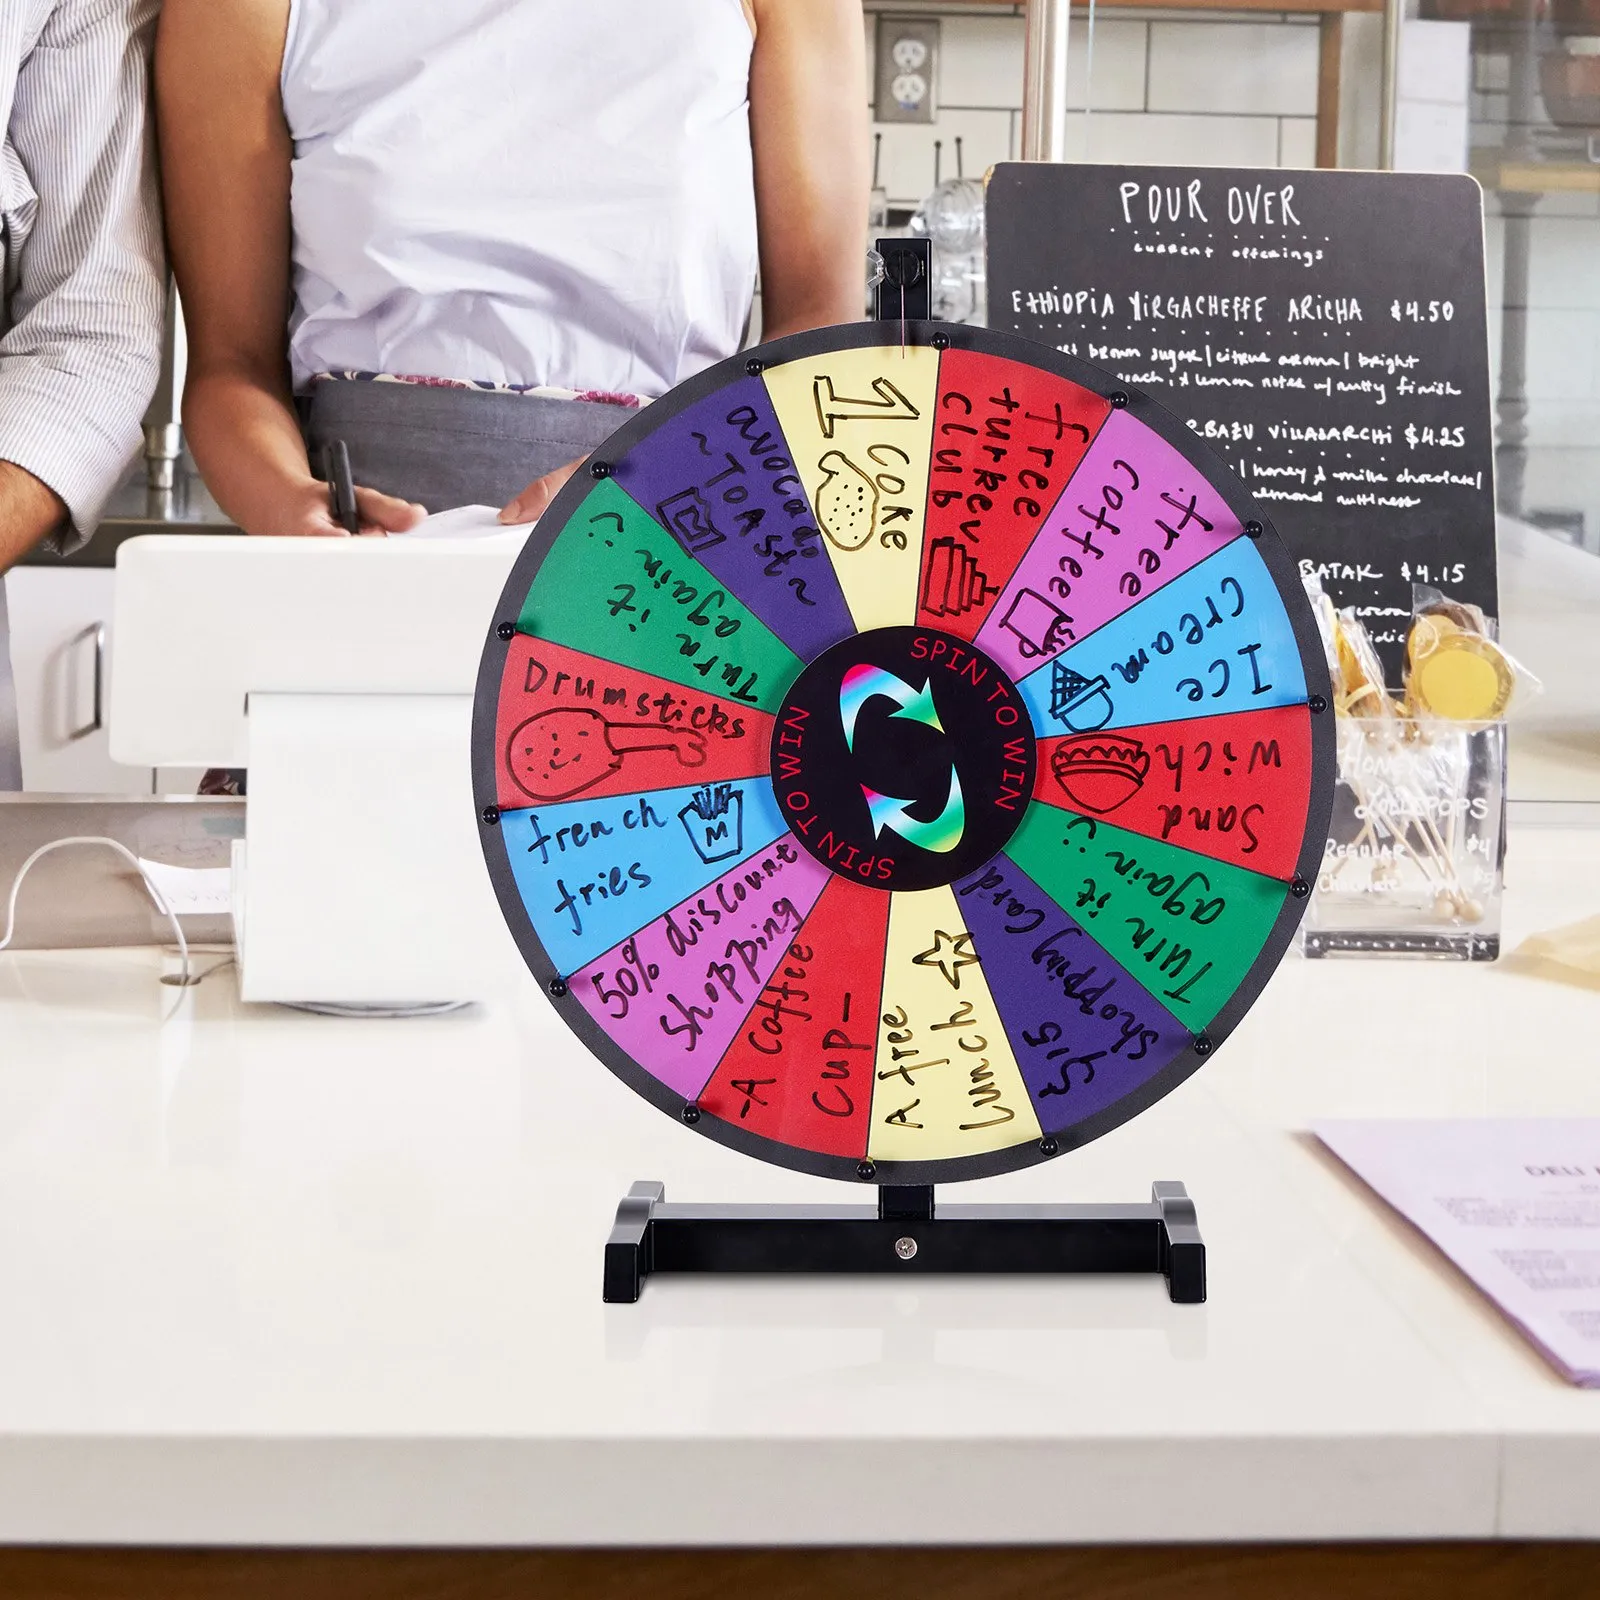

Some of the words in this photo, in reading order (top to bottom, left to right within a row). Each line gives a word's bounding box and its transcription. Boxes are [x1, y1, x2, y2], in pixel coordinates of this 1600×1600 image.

[1119, 179, 1208, 224] POUR
[1227, 184, 1302, 226] OVER
[1390, 299, 1455, 323] $4.50
[1358, 352, 1420, 375] bright
[1396, 375, 1462, 396] finish
[1013, 402, 1090, 519] free
[1404, 422, 1466, 450] $4.25
[725, 405, 821, 560] avocado
[1252, 463, 1307, 485] honey
[1119, 491, 1215, 597] free
[1400, 561, 1466, 584] $4.15
[606, 583, 652, 633] it
[633, 549, 742, 638] again
[675, 632, 759, 703] Turn
[910, 637, 988, 687] SPIN
[1176, 642, 1273, 702] Ice
[523, 656, 746, 740] Drumsticks
[987, 681, 1019, 727] TO
[777, 705, 811, 781] WIN
[994, 737, 1027, 811] WIN
[786, 791, 819, 836] TO
[817, 831, 896, 880] SPIN
[553, 862, 652, 937] fries
[1075, 877, 1112, 919] it
[1104, 851, 1226, 926] again
[591, 936, 661, 1020] 50%
[1124, 917, 1213, 1005] Turn
[877, 1004, 951, 1088] free
[1021, 1021, 1108, 1099] $15
[883, 1098, 925, 1131] A
